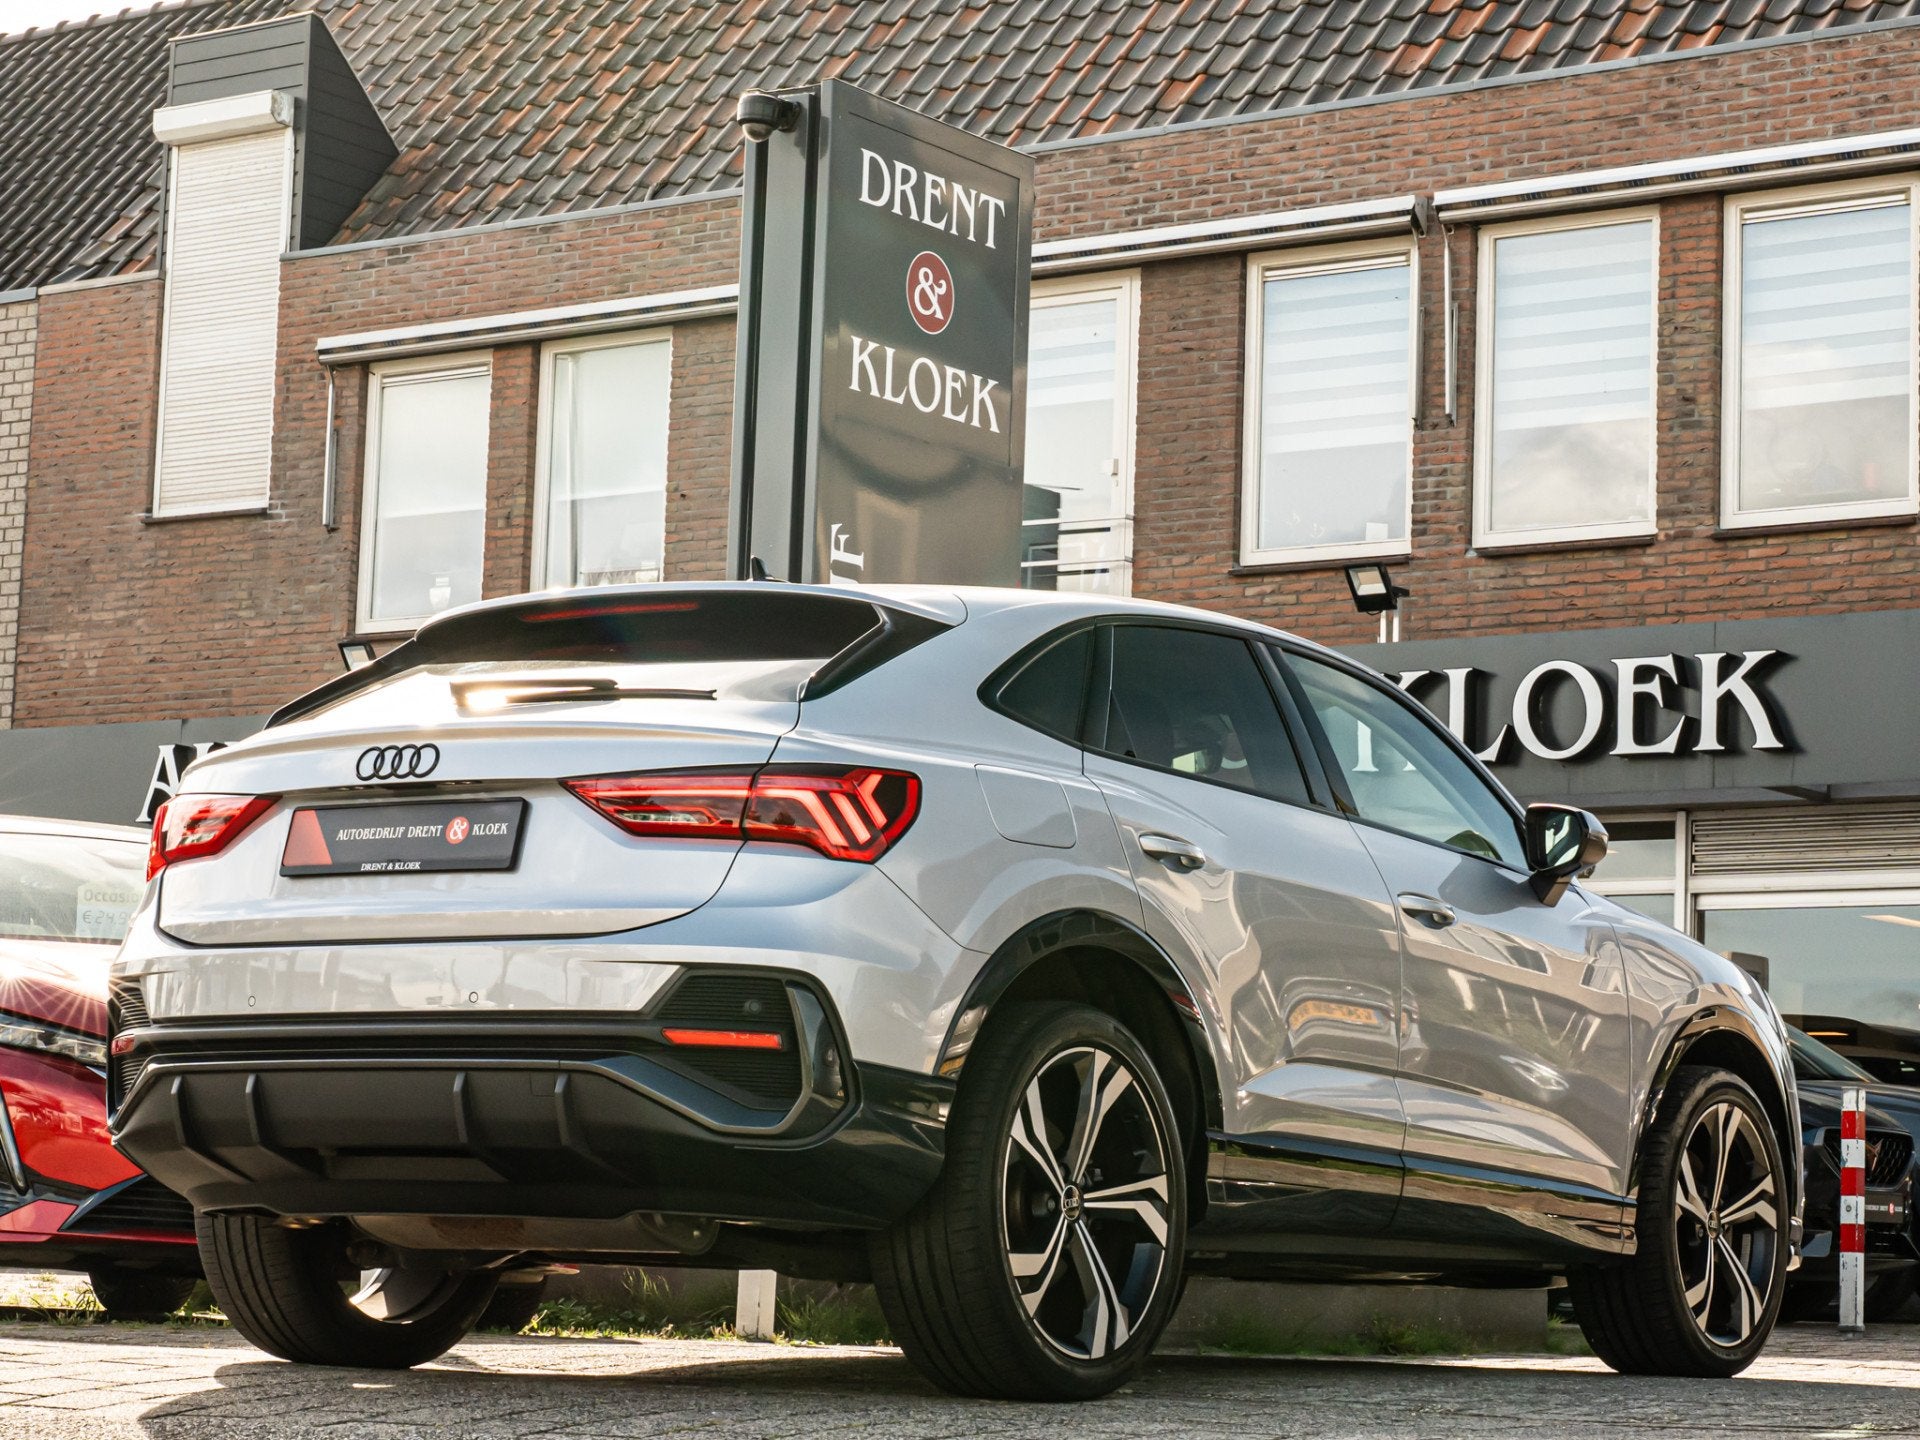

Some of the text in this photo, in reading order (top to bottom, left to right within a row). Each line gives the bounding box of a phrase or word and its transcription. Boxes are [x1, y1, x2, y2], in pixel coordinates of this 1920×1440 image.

[859, 148, 1005, 249] DRENT
[914, 267, 947, 320] &
[849, 335, 1000, 434] KLOEK
[336, 819, 508, 841] AUTOBEDRIJF DRENT & KLOEK
[361, 862, 387, 871] DRENT
[394, 861, 421, 870] KLOEK
[84, 889, 143, 903] Occasio
